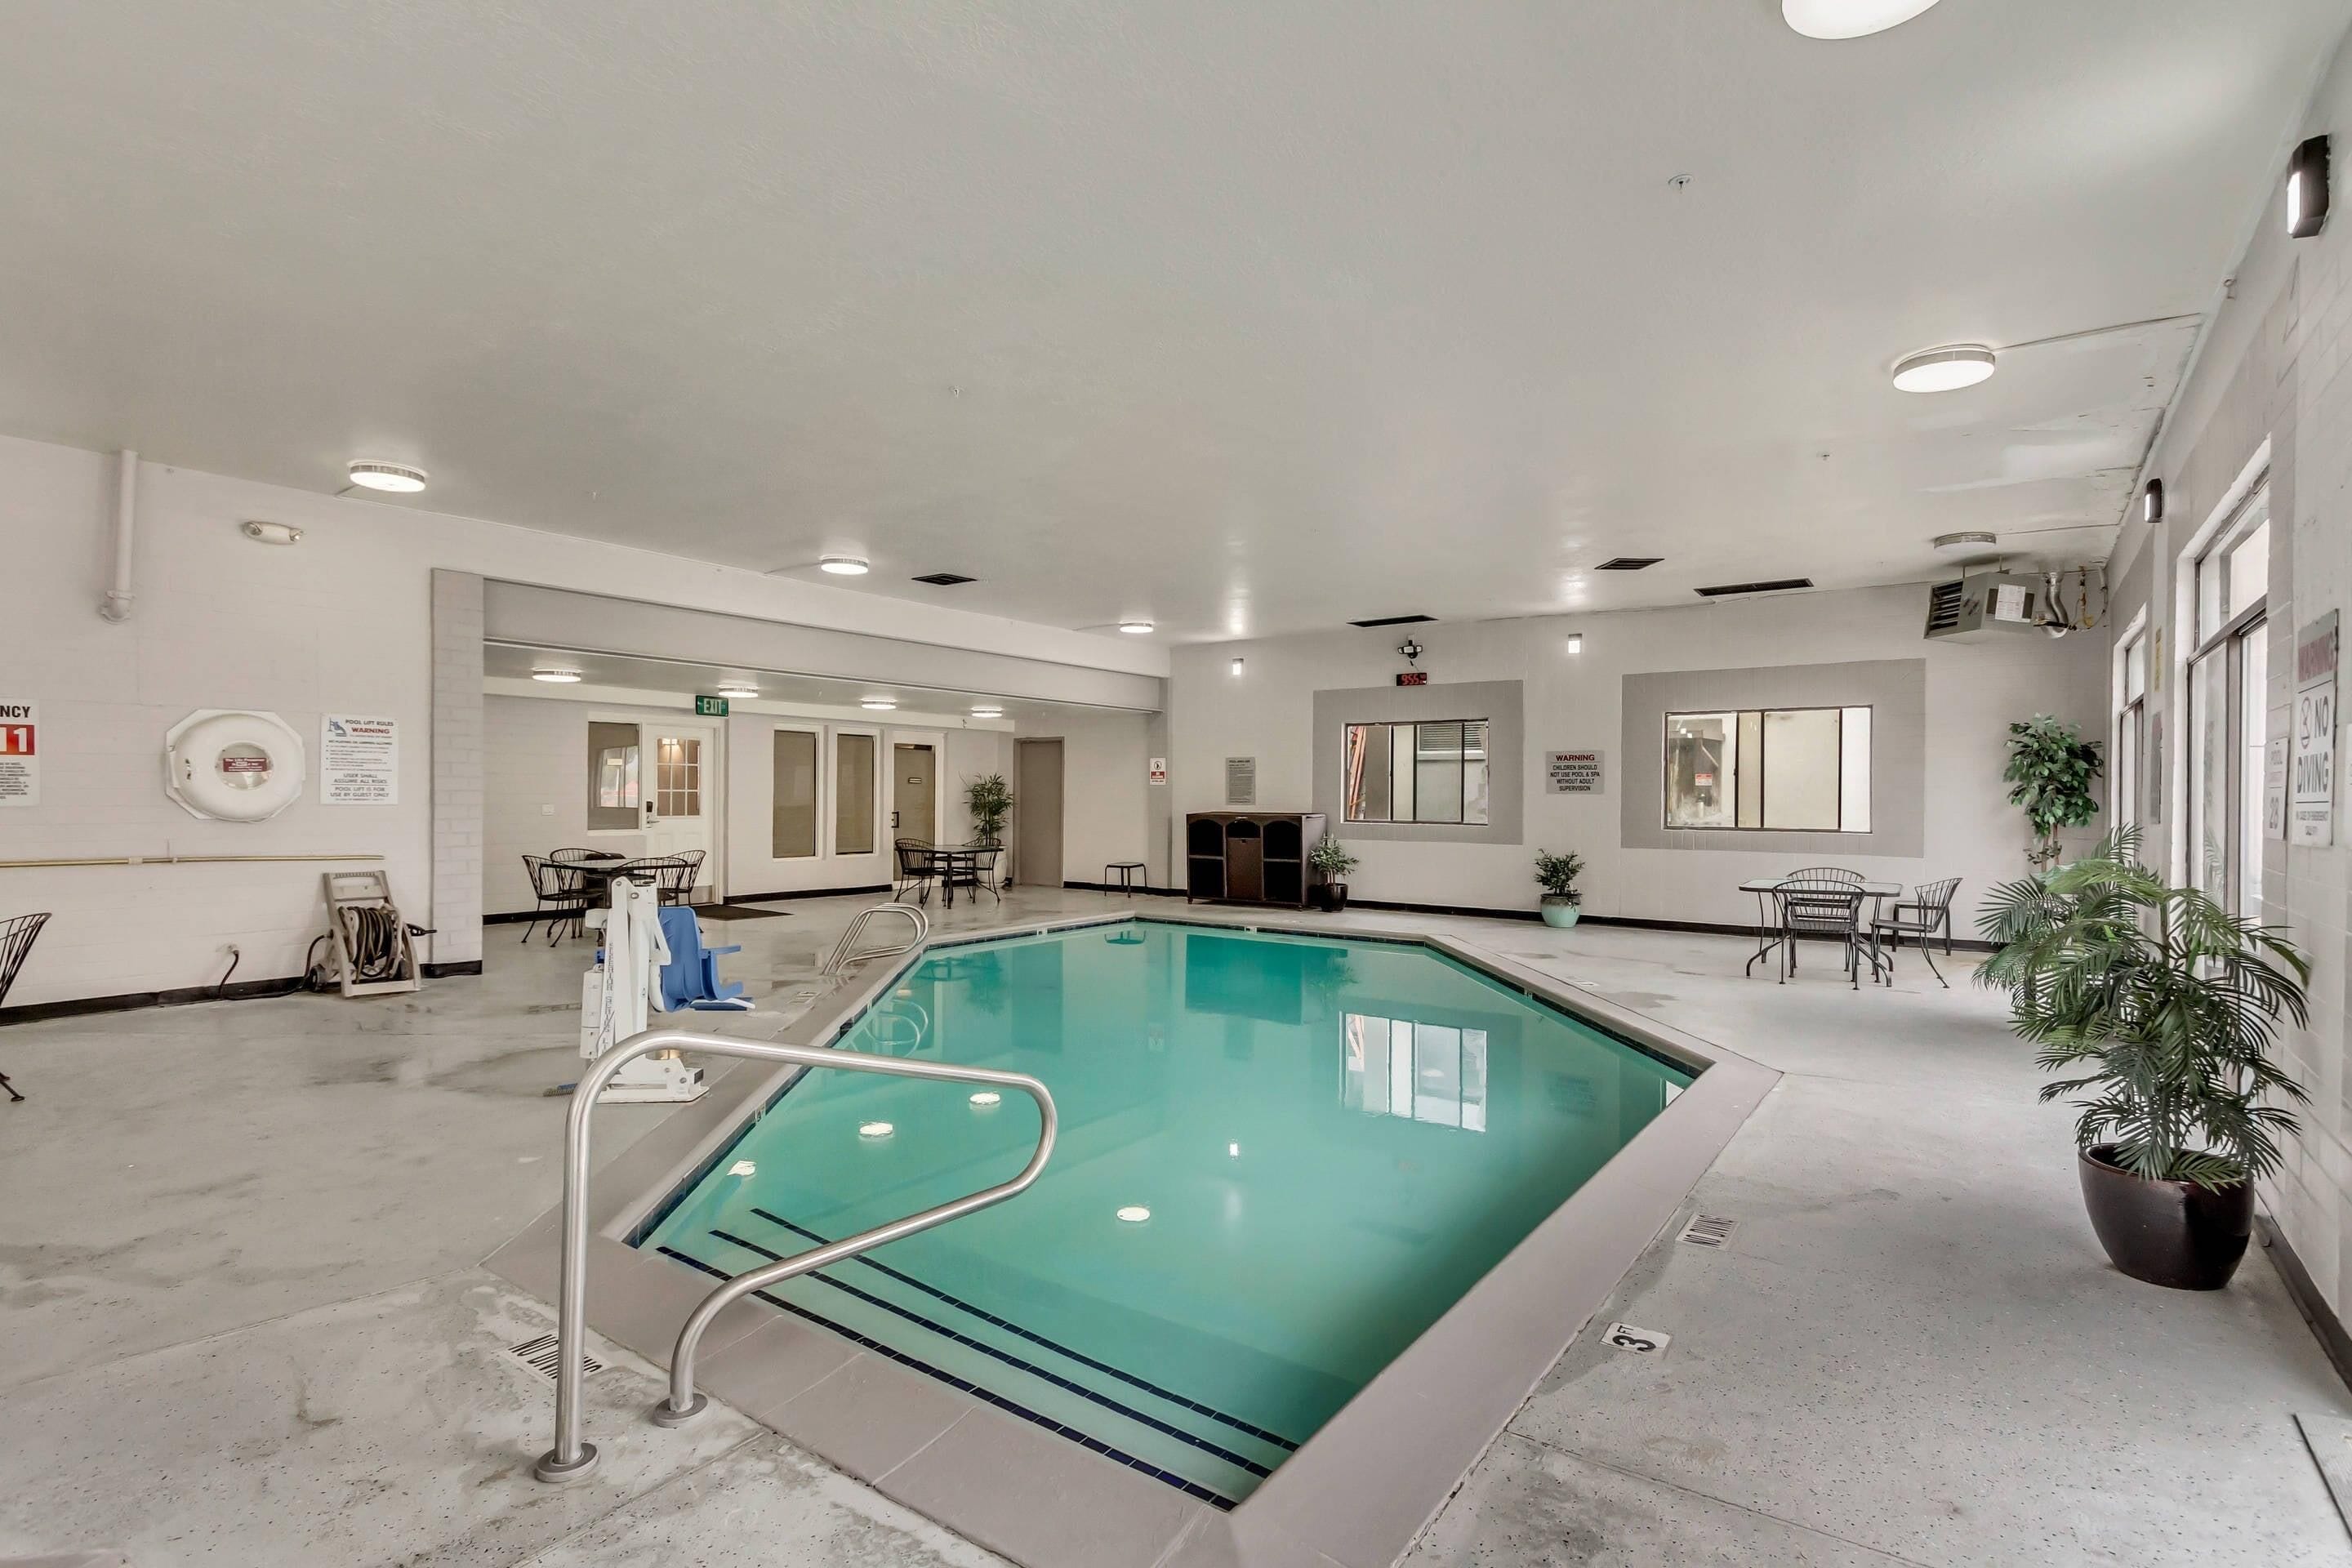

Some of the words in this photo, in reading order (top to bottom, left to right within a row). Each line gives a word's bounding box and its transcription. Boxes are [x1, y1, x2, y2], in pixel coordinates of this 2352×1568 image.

[704, 697, 722, 714] EXIT
[2314, 696, 2329, 738] NO
[2296, 751, 2329, 794] DIVING
[1689, 1214, 1733, 1238] DIVING
[1682, 1234, 1722, 1249] NO
[1616, 1325, 1634, 1335] FT
[507, 1334, 559, 1357] NO
[1612, 1334, 1656, 1352] 3
